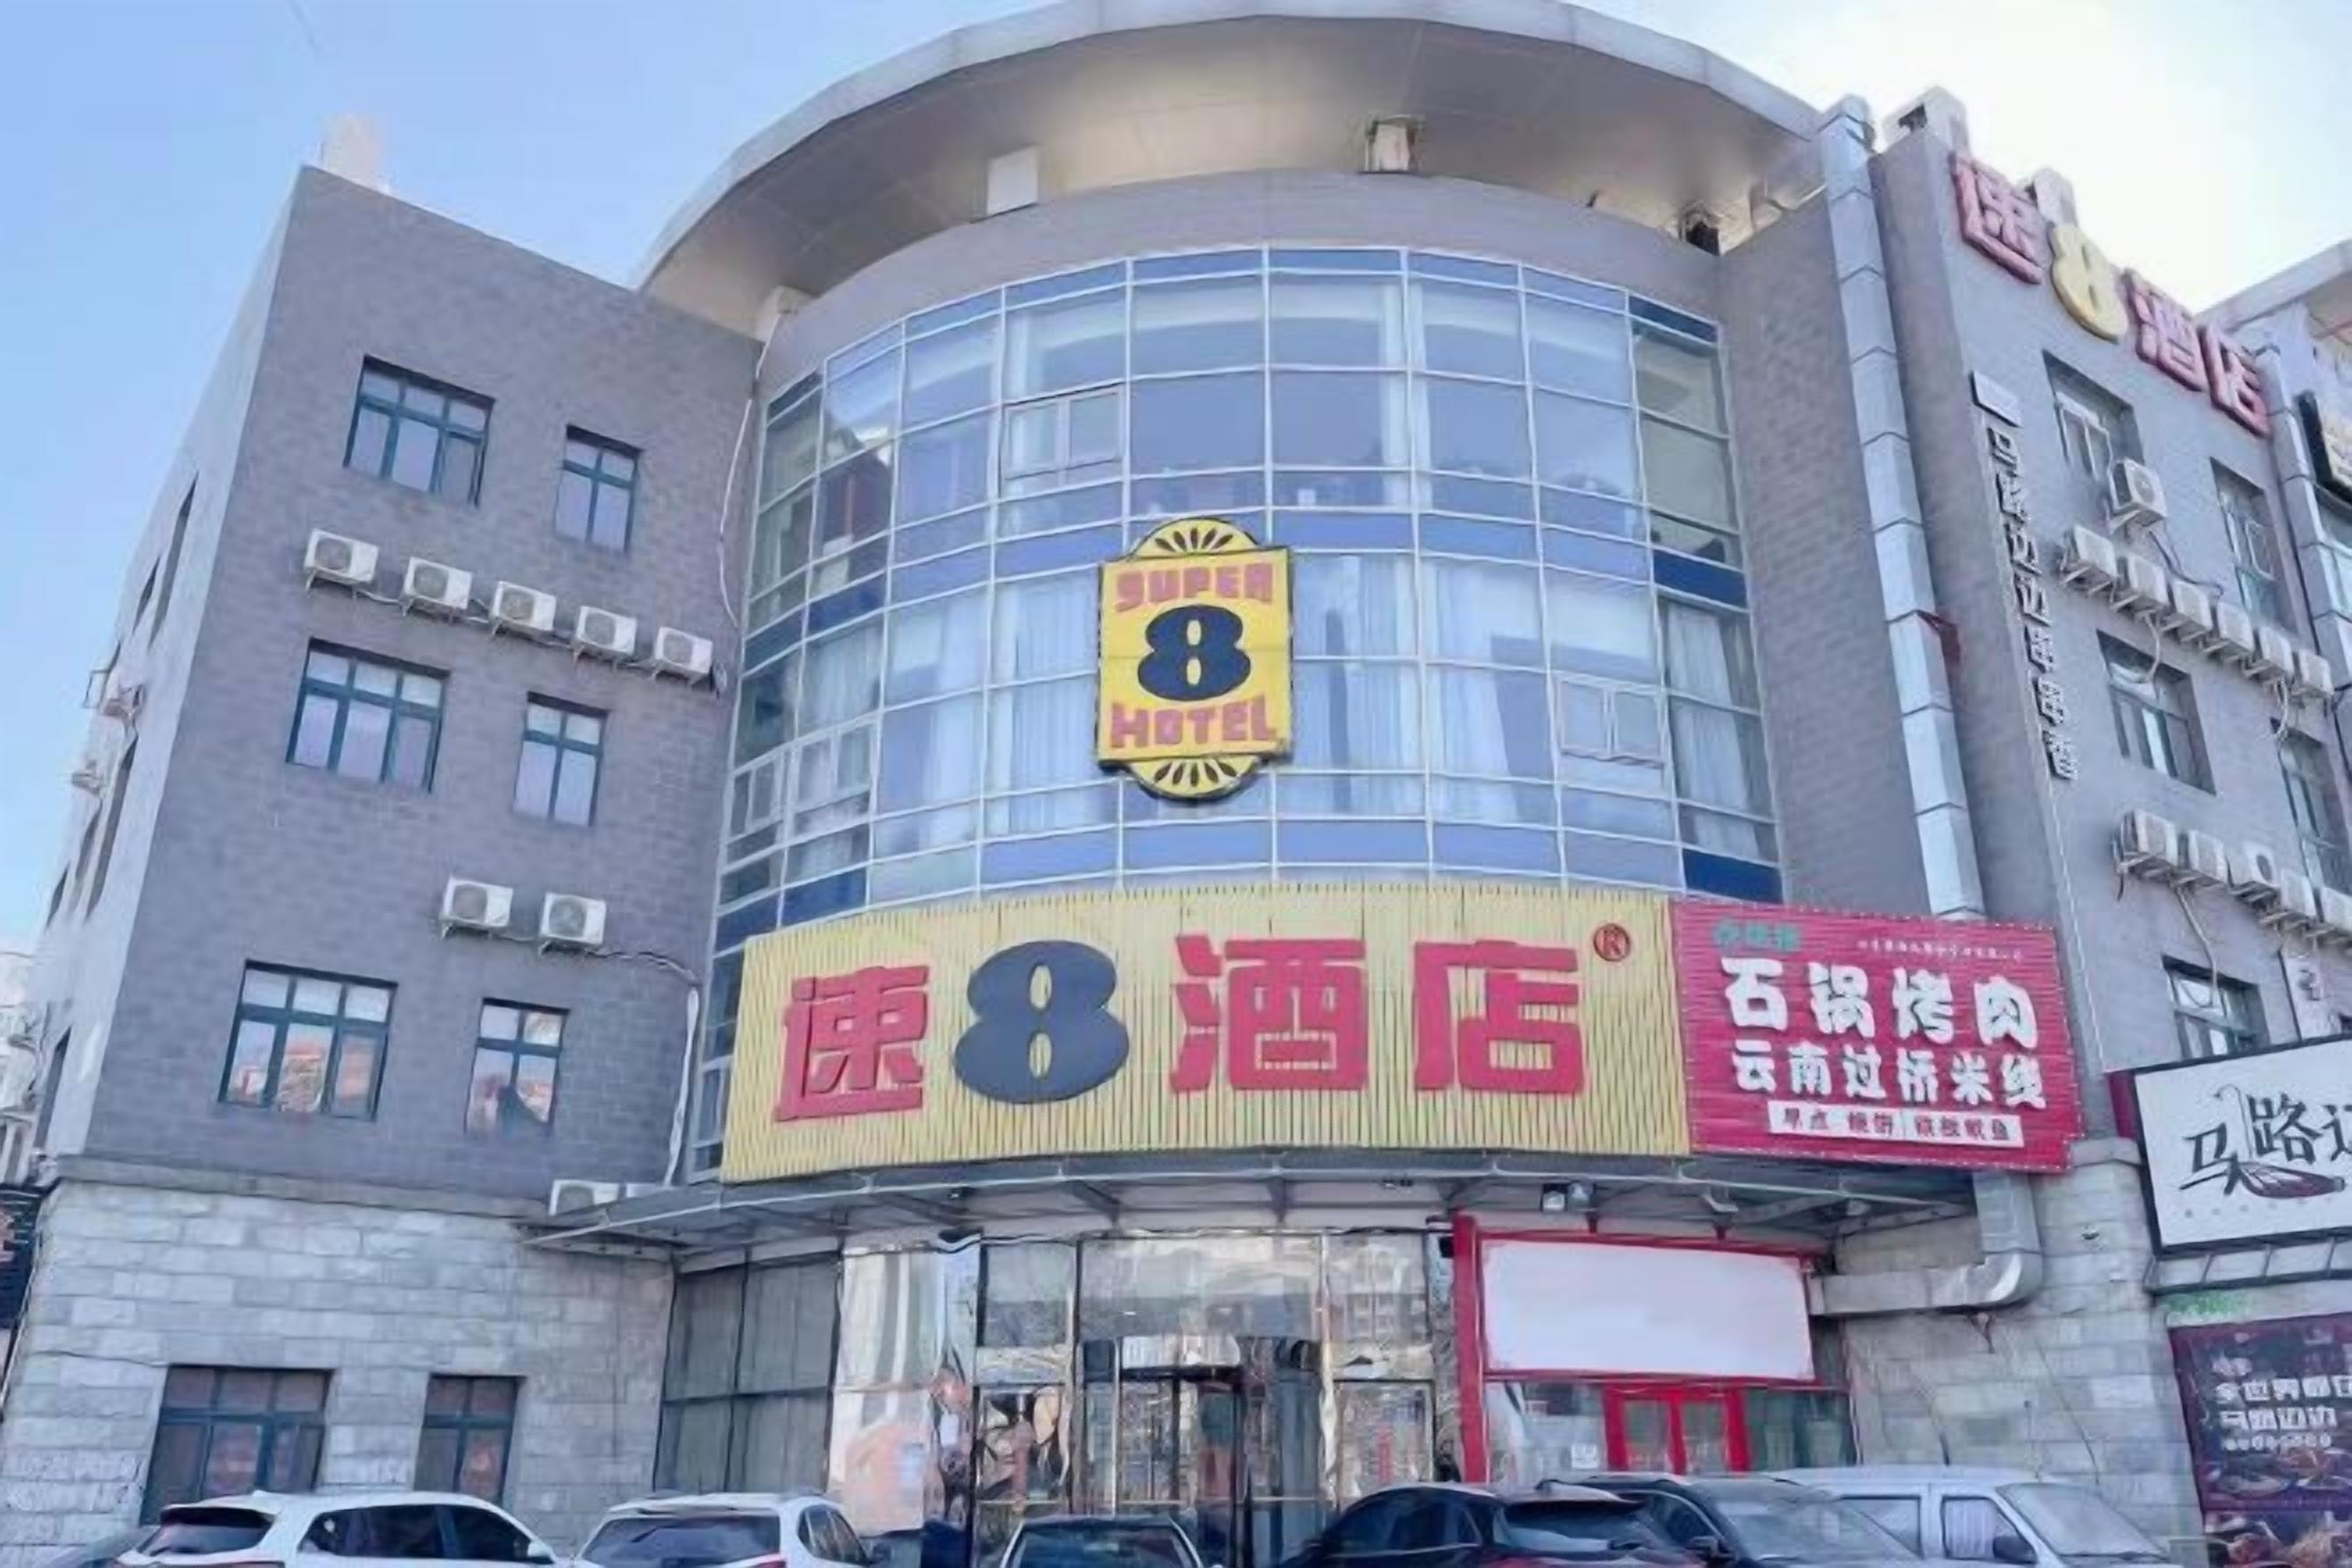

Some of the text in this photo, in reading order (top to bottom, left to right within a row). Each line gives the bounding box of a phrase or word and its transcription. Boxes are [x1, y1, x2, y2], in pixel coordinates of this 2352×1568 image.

[1114, 563, 1274, 613] SUPER
[1138, 604, 1252, 701] 8
[1109, 695, 1278, 748] HOTEL
[773, 933, 1586, 1123] 速8酒店
[1721, 956, 2038, 1049] 石锅烤肉
[1732, 1039, 2046, 1109] 云南过桥米线
